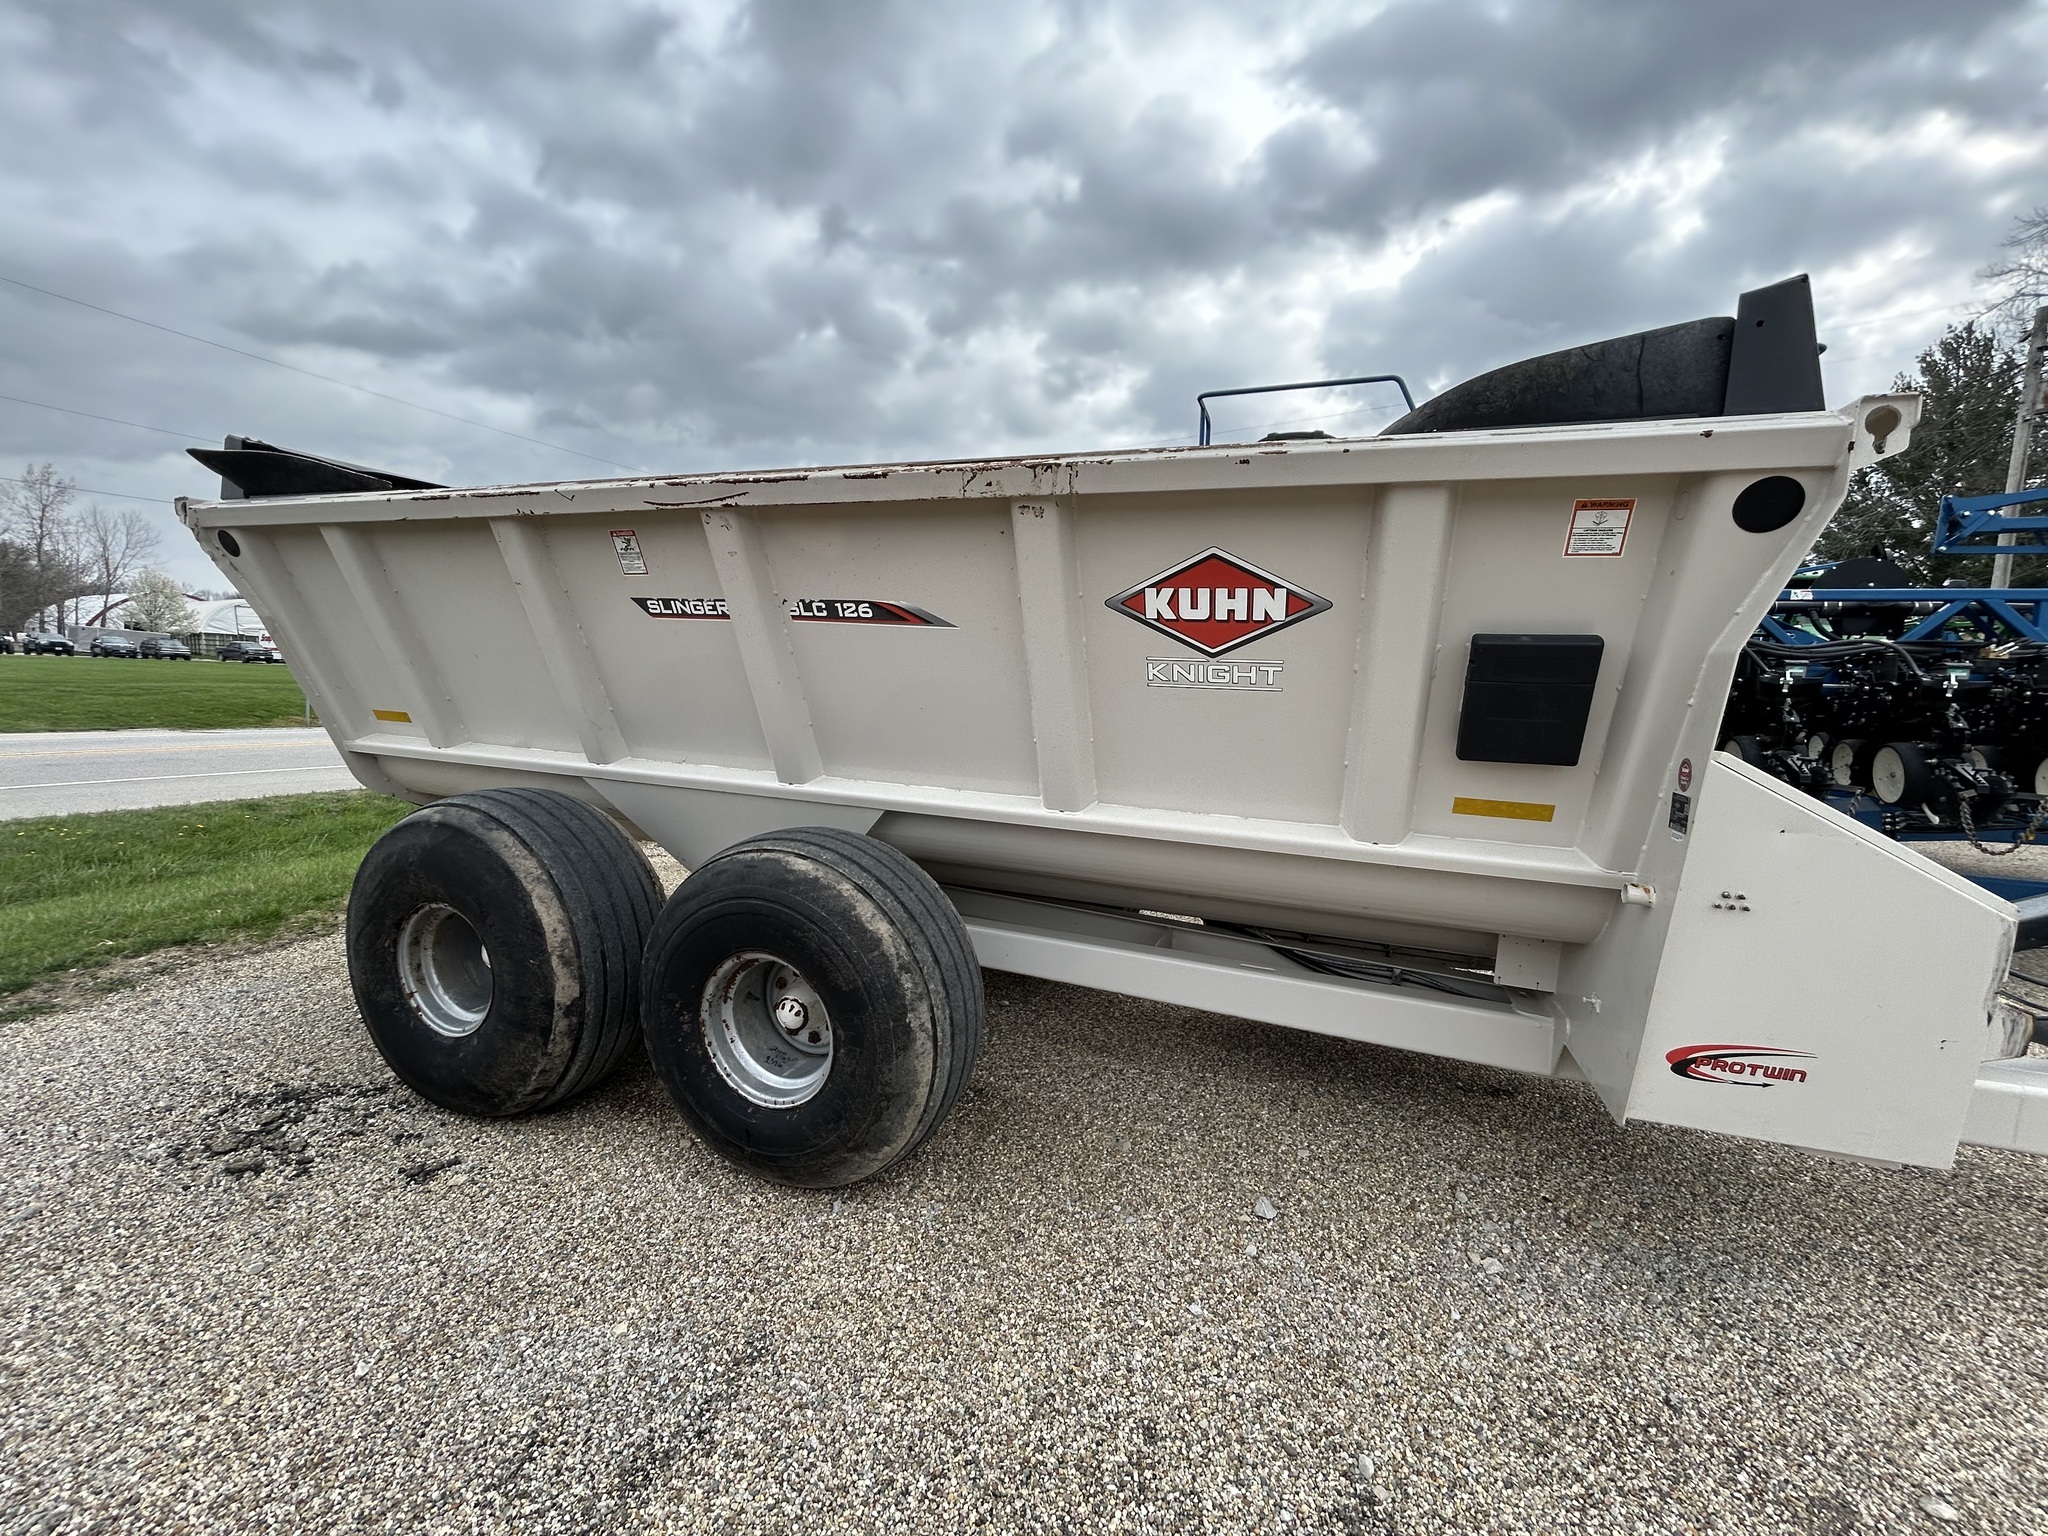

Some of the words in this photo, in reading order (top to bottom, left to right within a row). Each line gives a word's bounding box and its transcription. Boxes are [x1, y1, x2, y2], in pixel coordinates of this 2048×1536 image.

[646, 599, 730, 615] SLINGER
[790, 601, 828, 617] SLC
[834, 602, 873, 618] 126
[1144, 587, 1288, 622] KUHN
[1146, 662, 1284, 686] KNIGHT
[1694, 1056, 1808, 1083] PROTWIN
